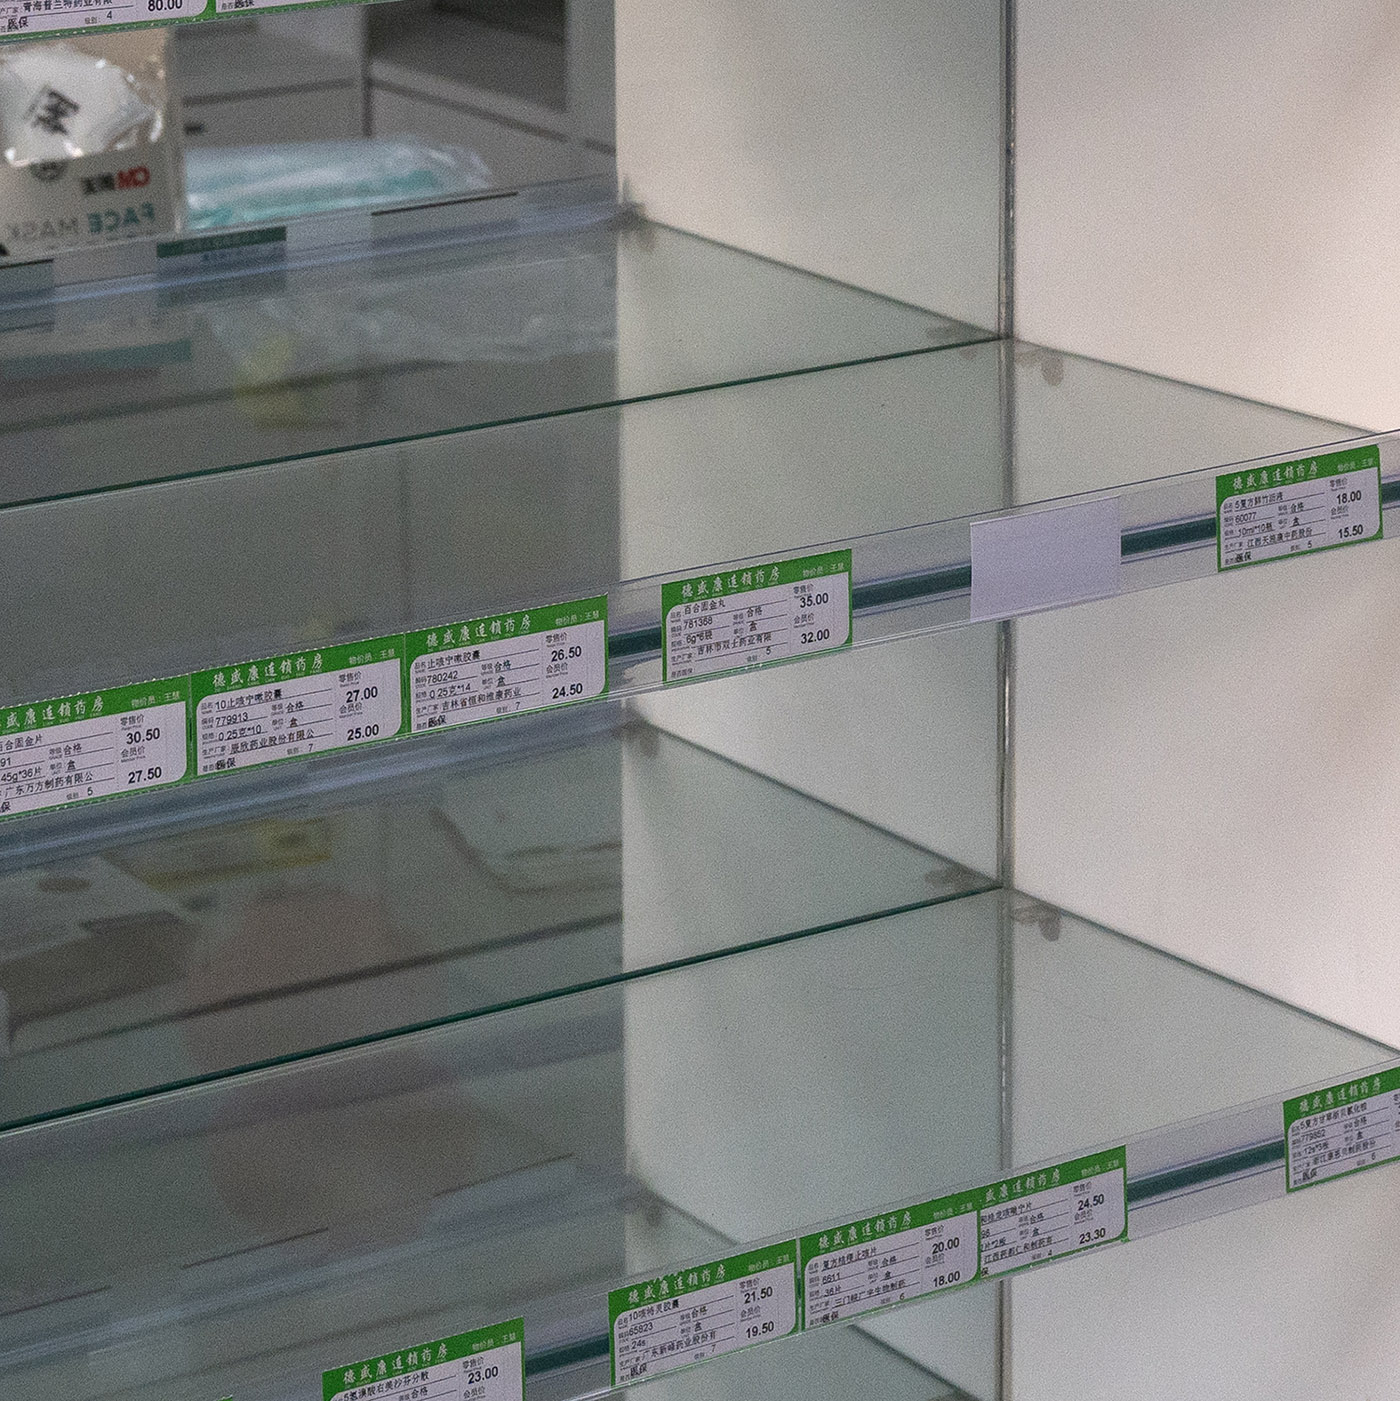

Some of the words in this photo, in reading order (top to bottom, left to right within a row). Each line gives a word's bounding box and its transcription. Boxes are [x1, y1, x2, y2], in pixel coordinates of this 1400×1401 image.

[1337, 490, 1362, 505] 18.00
[1338, 524, 1363, 538] 15.50
[800, 592, 829, 608] 35.00
[801, 629, 830, 644] 32.00
[551, 646, 582, 663] 26.50
[427, 671, 458, 684] 780242
[346, 686, 378, 703] 27.00
[552, 683, 583, 699] 24.50
[215, 712, 248, 726] 779913
[126, 728, 160, 745] 30.50
[347, 724, 380, 740] 25.00
[128, 766, 162, 784] 27.50
[1078, 1193, 1105, 1211] 24.50
[1079, 1228, 1106, 1244] 23.30
[932, 1237, 960, 1254] 20.00
[933, 1271, 960, 1288] 18.00
[744, 1286, 773, 1304] 21.50
[746, 1321, 774, 1338] 19.50
[467, 1366, 499, 1385] 23.00
